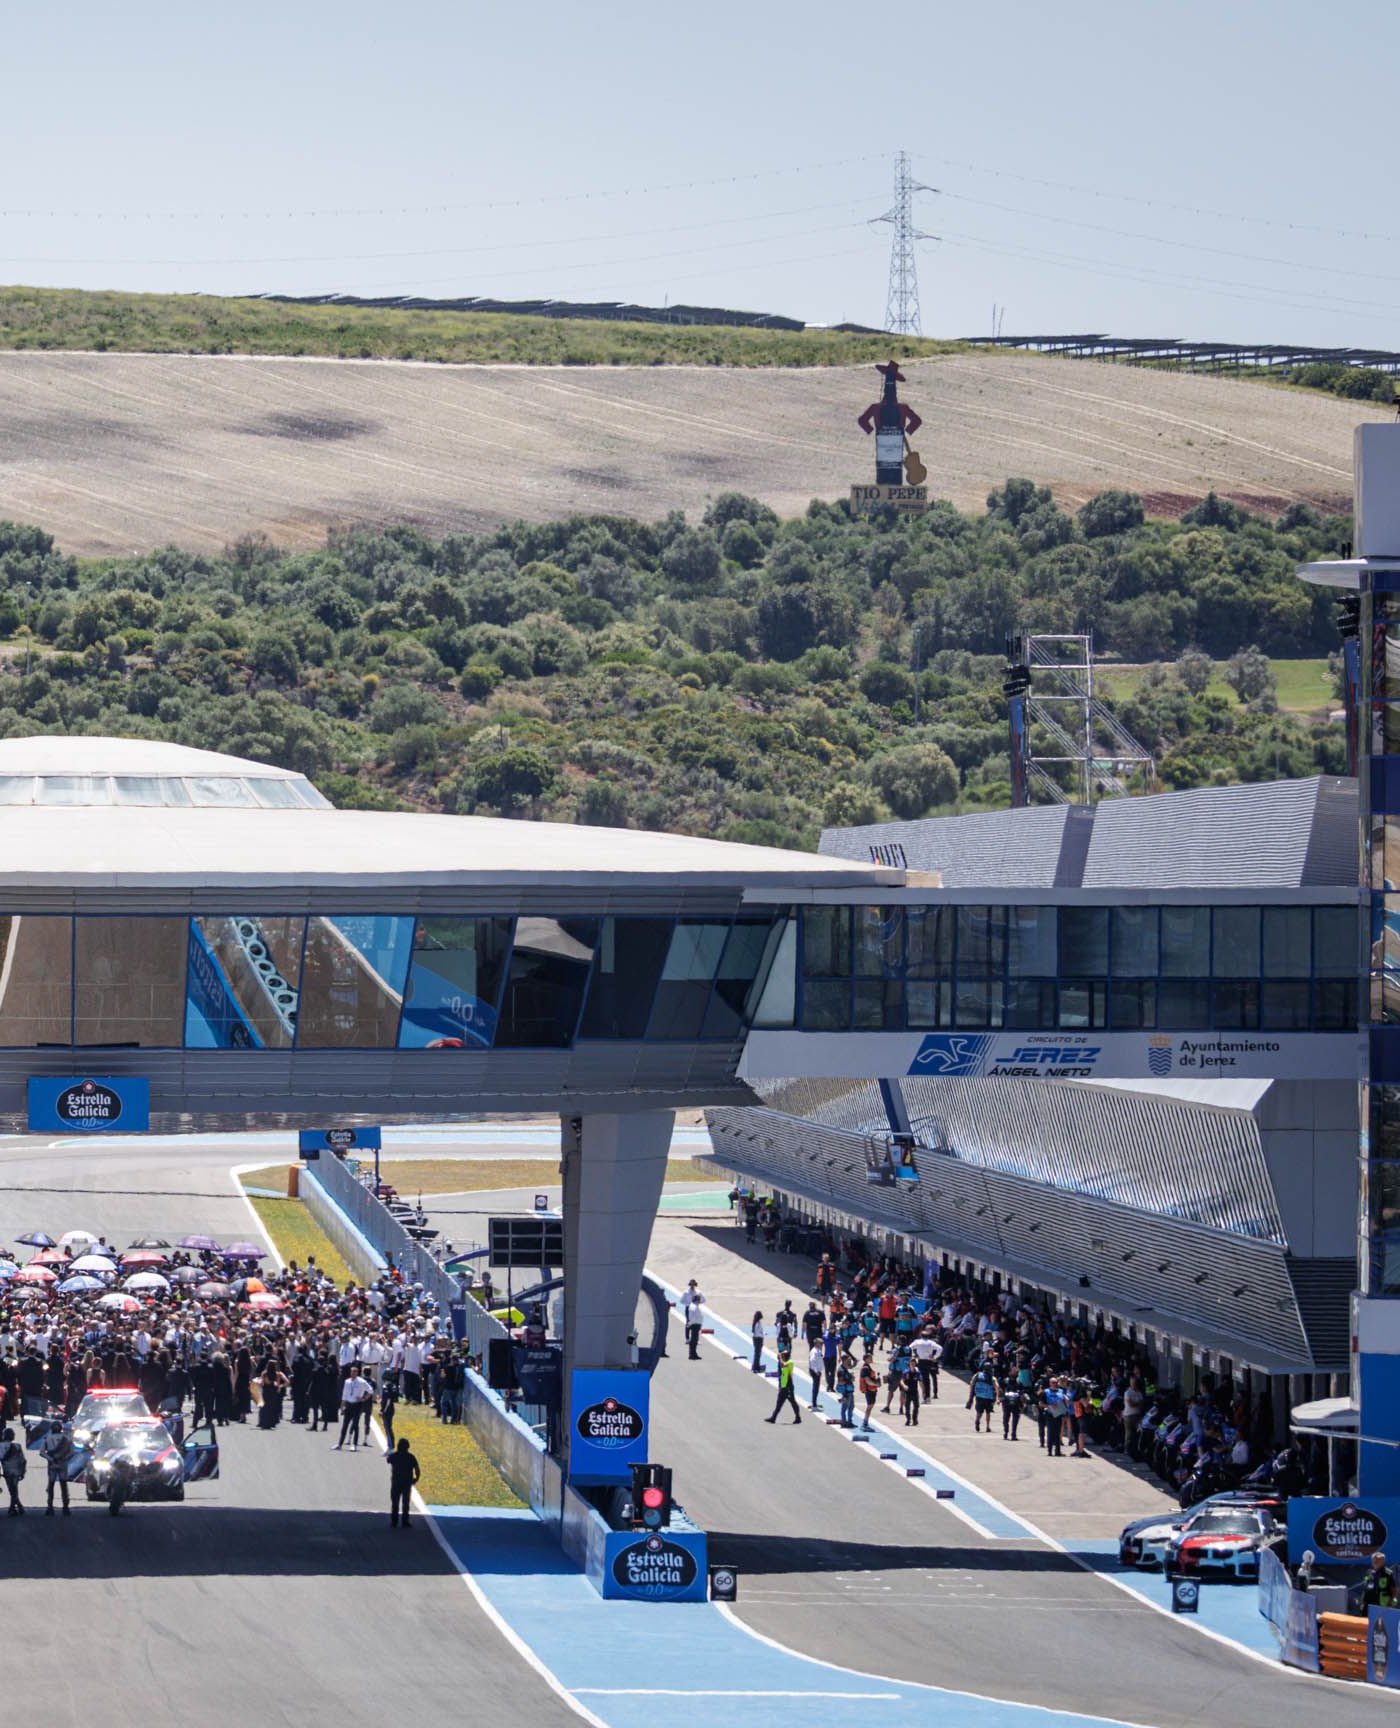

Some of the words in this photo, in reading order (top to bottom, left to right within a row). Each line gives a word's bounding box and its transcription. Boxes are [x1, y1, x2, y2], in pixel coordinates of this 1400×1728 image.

[853, 487, 881, 499] TIO
[887, 487, 927, 500] PEPE
[1027, 1036, 1073, 1044] CIRCUITO
[1180, 1040, 1280, 1054] Ayuntamiento
[996, 1047, 1102, 1064] JEREZ
[1179, 1055, 1196, 1066] de
[1199, 1055, 1237, 1068] Jerez
[987, 1065, 1042, 1077] ÁNGEL
[1044, 1067, 1092, 1077] NIETO
[66, 1093, 112, 1105] Estrella
[68, 1105, 110, 1117] Galicia
[587, 1411, 633, 1424] Estrella
[589, 1423, 631, 1436] Galicia
[1325, 1518, 1374, 1531] Estrella
[1326, 1532, 1372, 1545] Galicia
[626, 1552, 684, 1567] Estrella
[628, 1566, 681, 1583] Galicia
[715, 1576, 733, 1586] 60
[1178, 1586, 1197, 1598] 60
